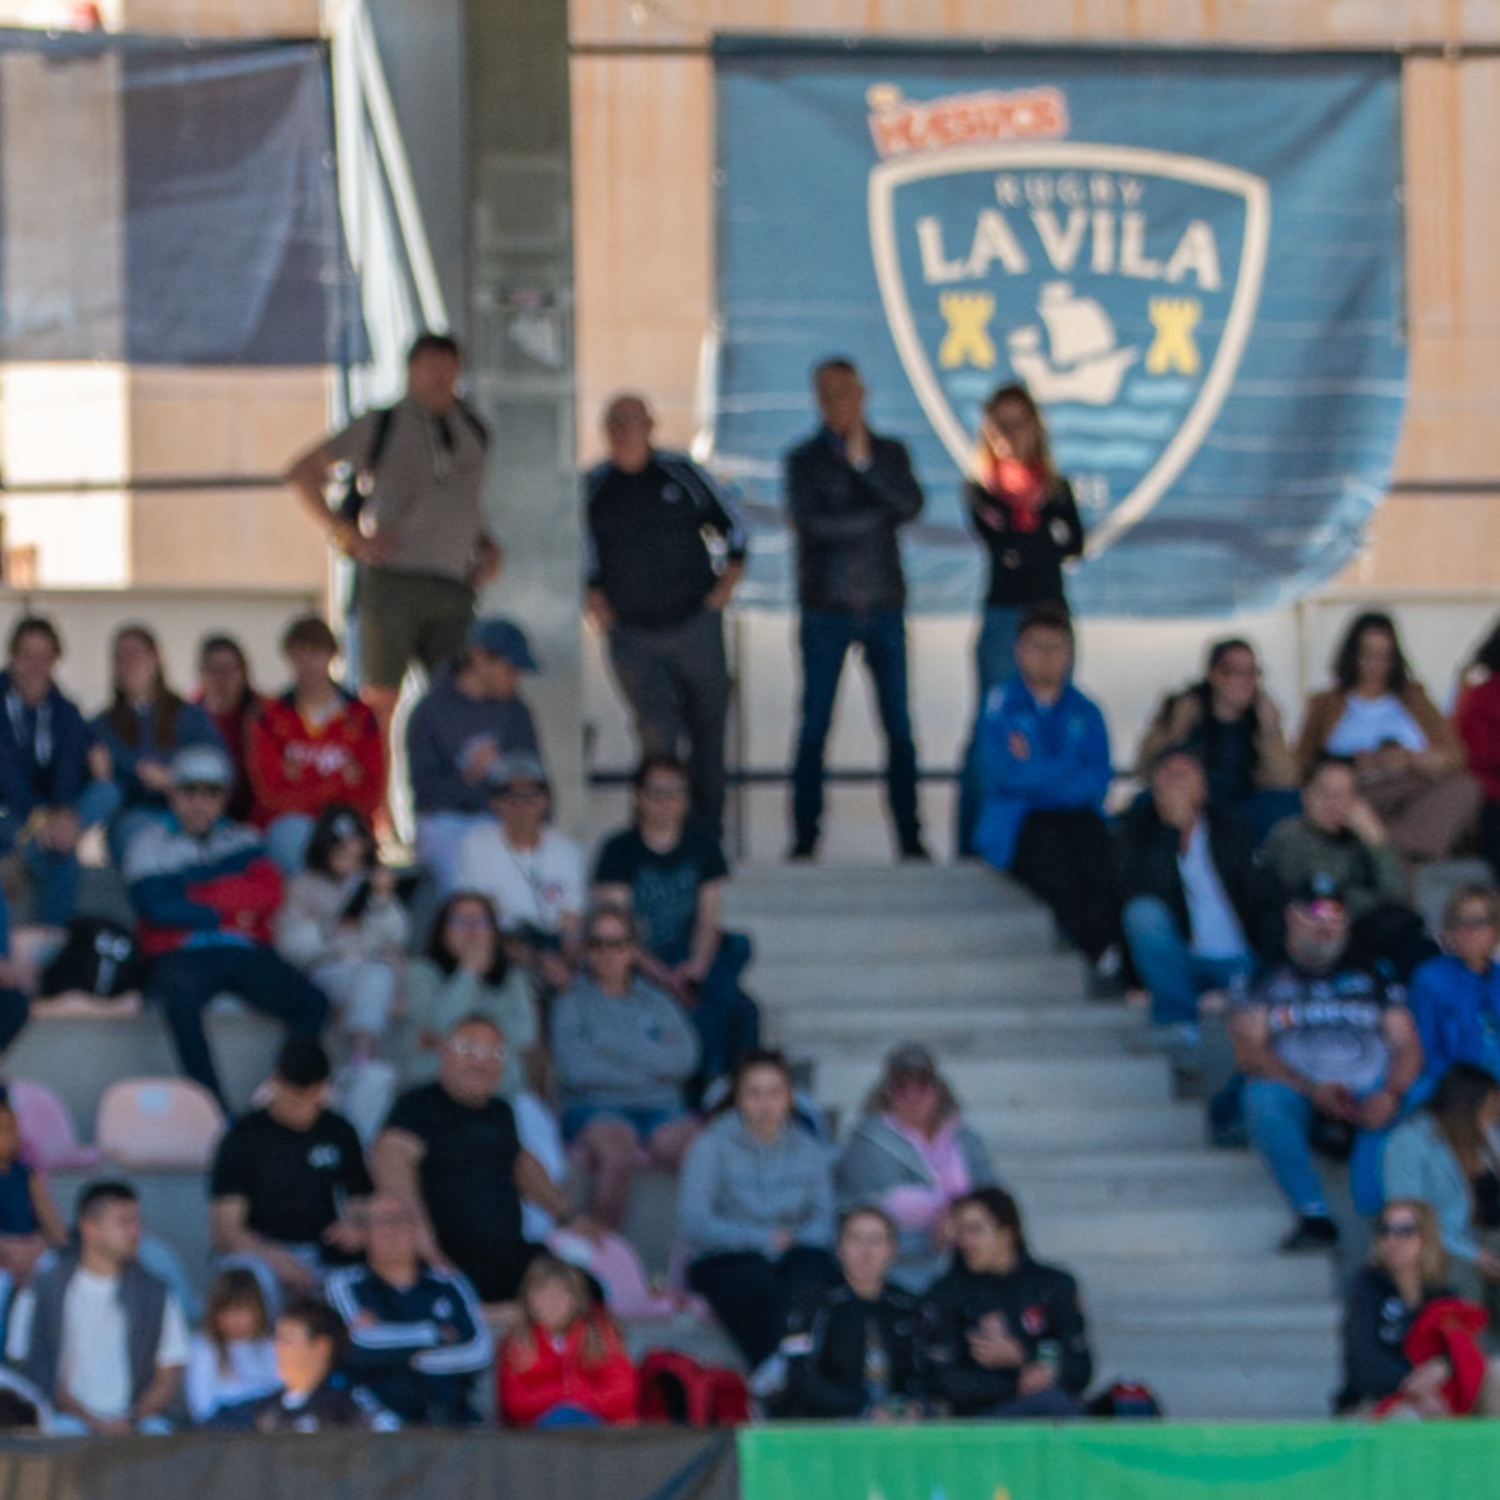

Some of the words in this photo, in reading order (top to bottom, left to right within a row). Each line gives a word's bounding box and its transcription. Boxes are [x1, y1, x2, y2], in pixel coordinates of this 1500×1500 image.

[995, 172, 1146, 206] RUGBY
[916, 208, 1029, 284] LA
[1030, 208, 1223, 291] VILA
